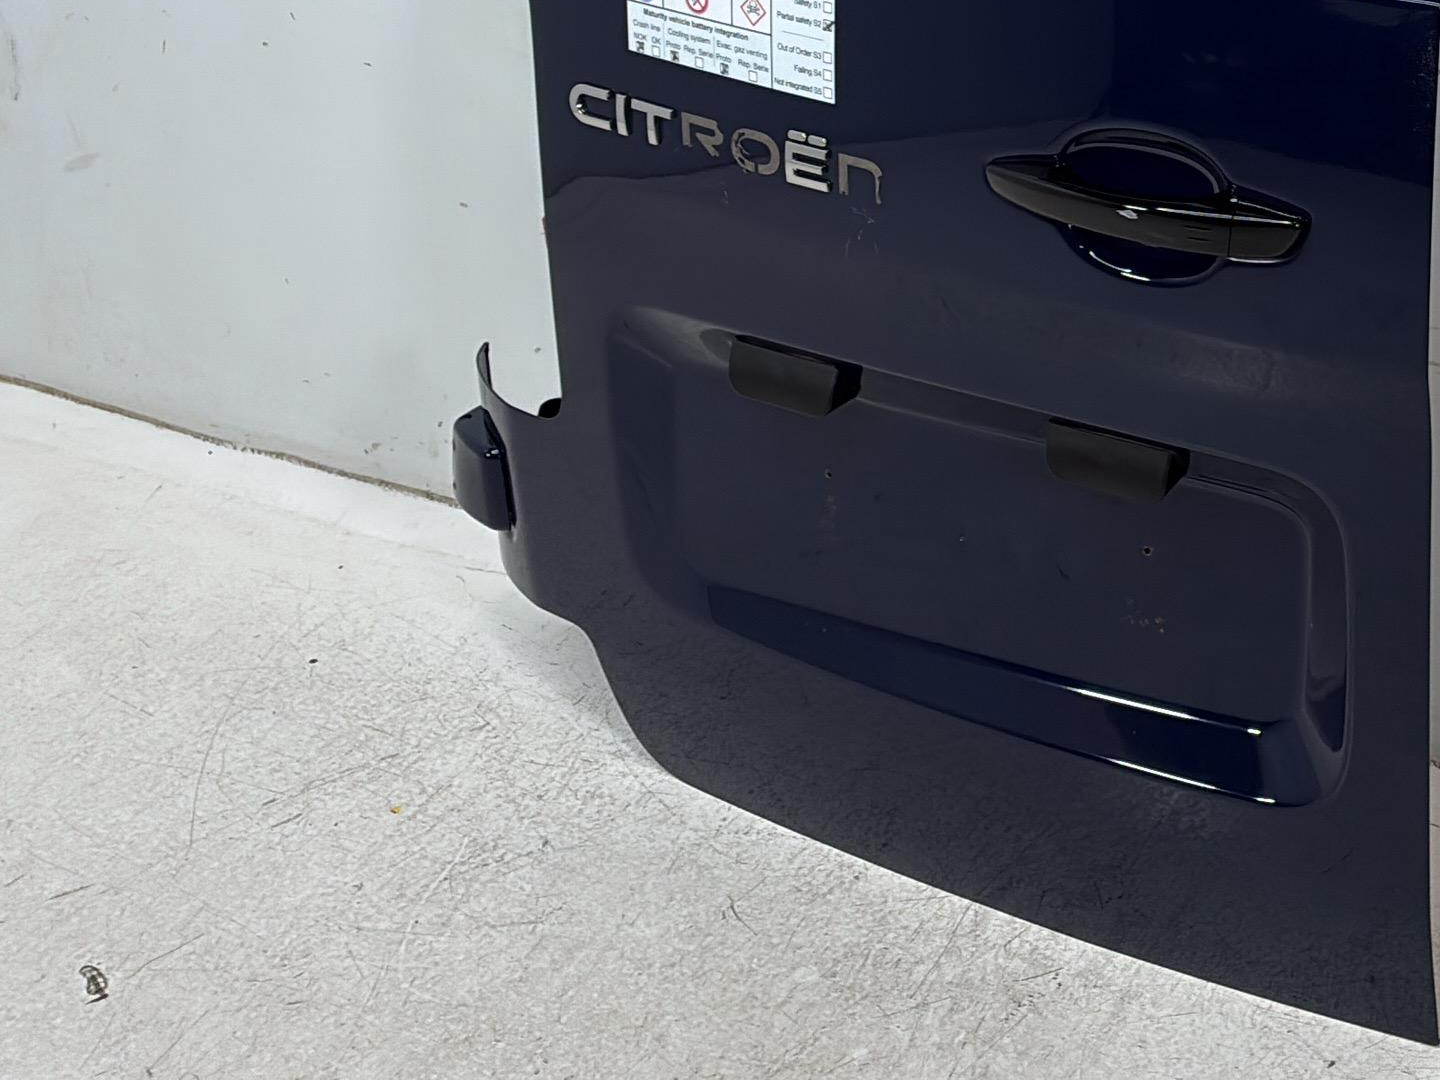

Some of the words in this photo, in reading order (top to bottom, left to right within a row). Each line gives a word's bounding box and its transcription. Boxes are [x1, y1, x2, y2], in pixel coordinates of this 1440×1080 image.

[643, 8, 667, 22] Maturity
[669, 15, 690, 26] vehicle
[691, 20, 713, 33] battery
[714, 26, 749, 40] integration
[795, 16, 812, 27] safety
[633, 32, 647, 41] NOK
[651, 36, 661, 44] OK
[667, 28, 689, 41] Cooling
[690, 33, 711, 45] system
[777, 42, 788, 52] Out
[795, 47, 812, 57] Order
